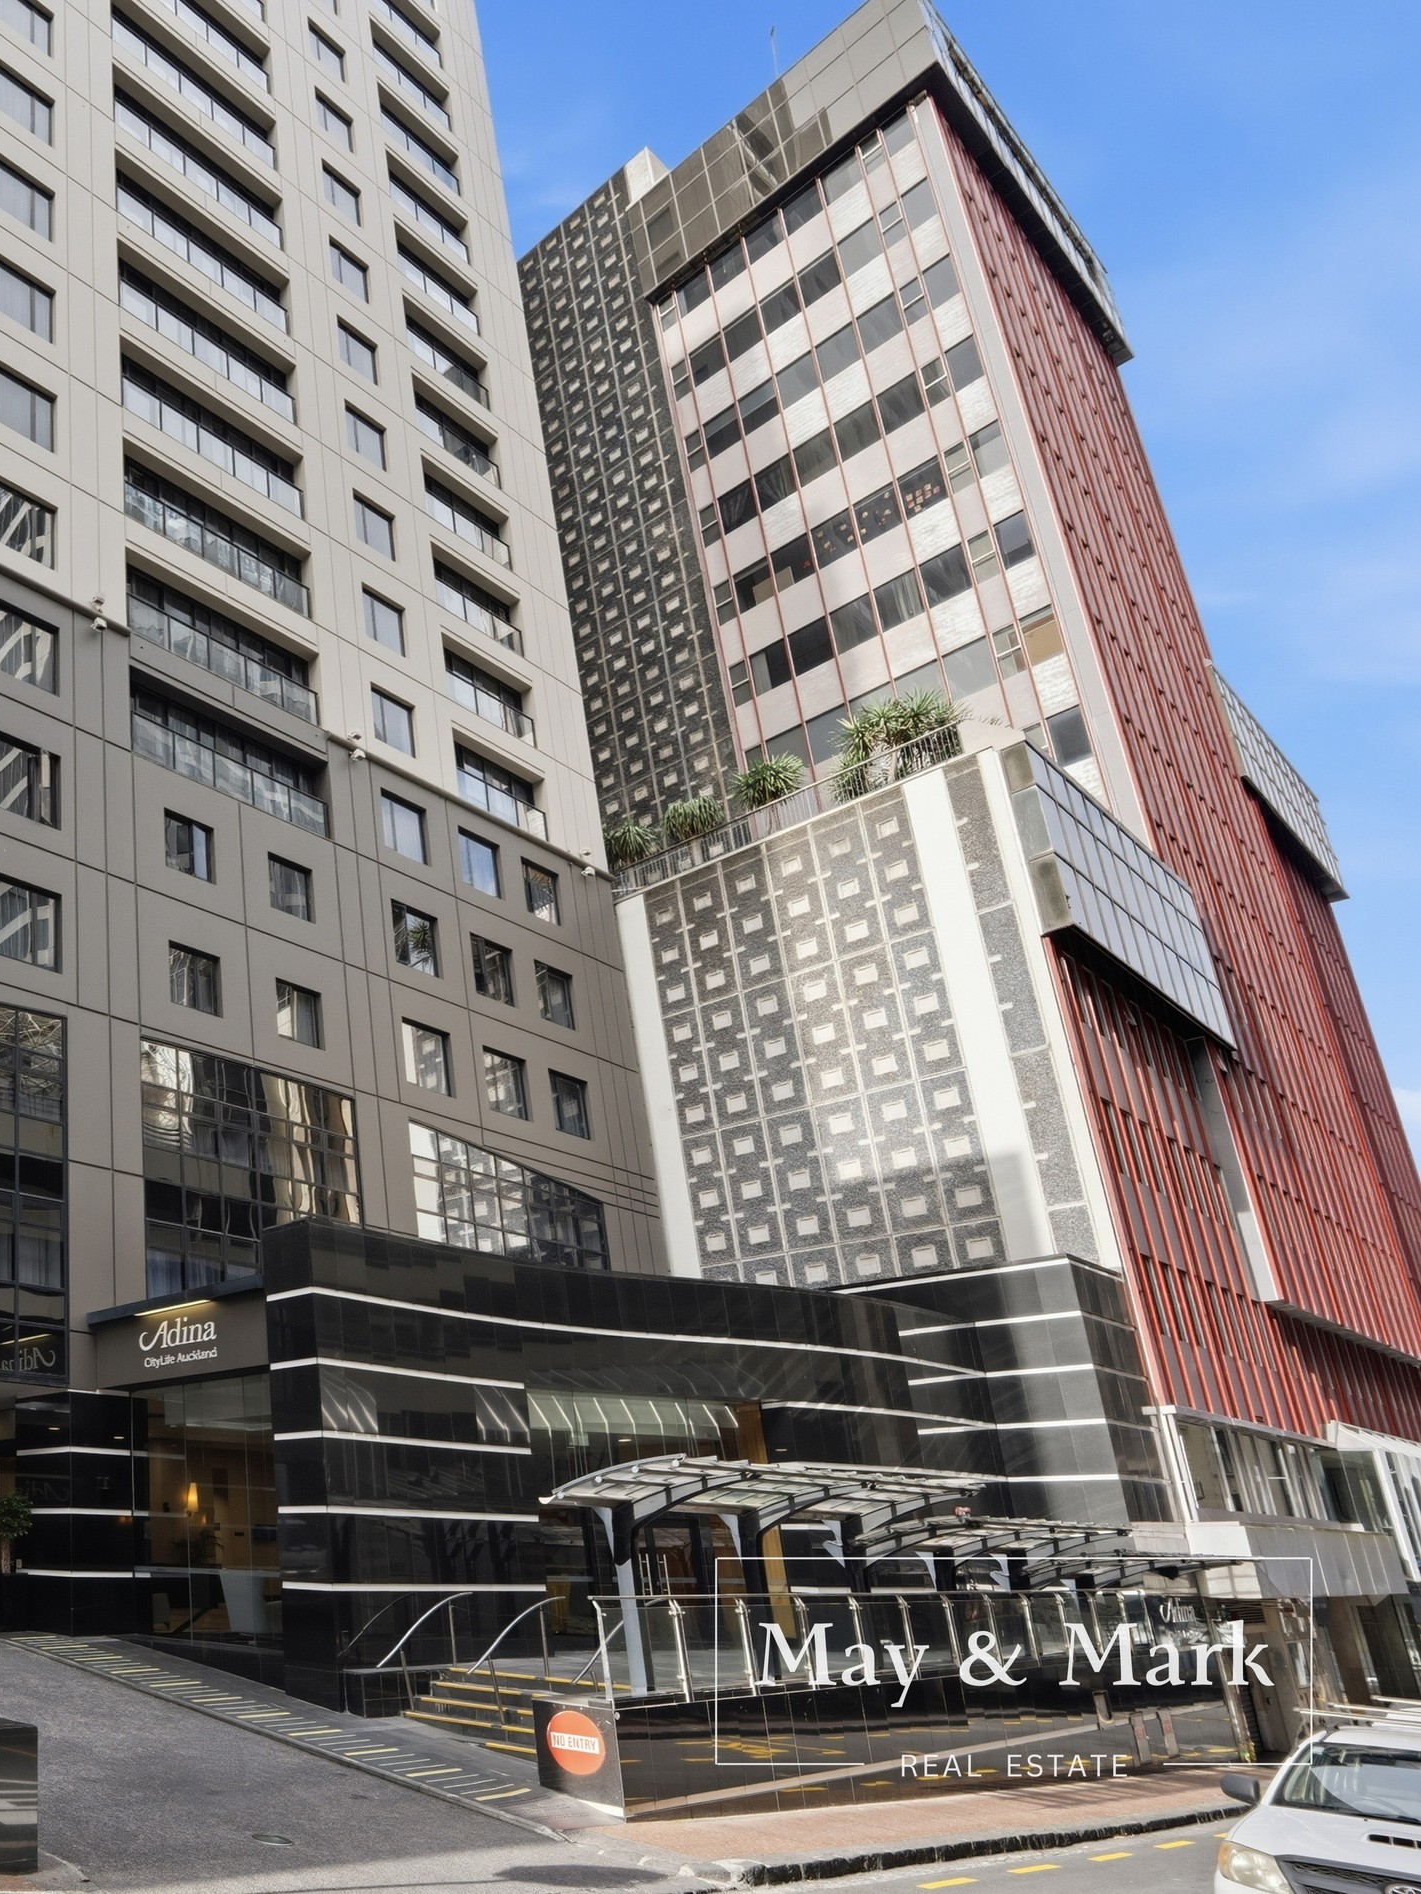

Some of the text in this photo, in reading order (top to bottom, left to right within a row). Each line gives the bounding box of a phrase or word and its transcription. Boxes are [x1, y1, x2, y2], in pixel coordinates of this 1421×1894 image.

[139, 1316, 218, 1351] Adina
[144, 1346, 218, 1369] CityLife Auckland
[552, 1734, 596, 1751] NO ENTRY
